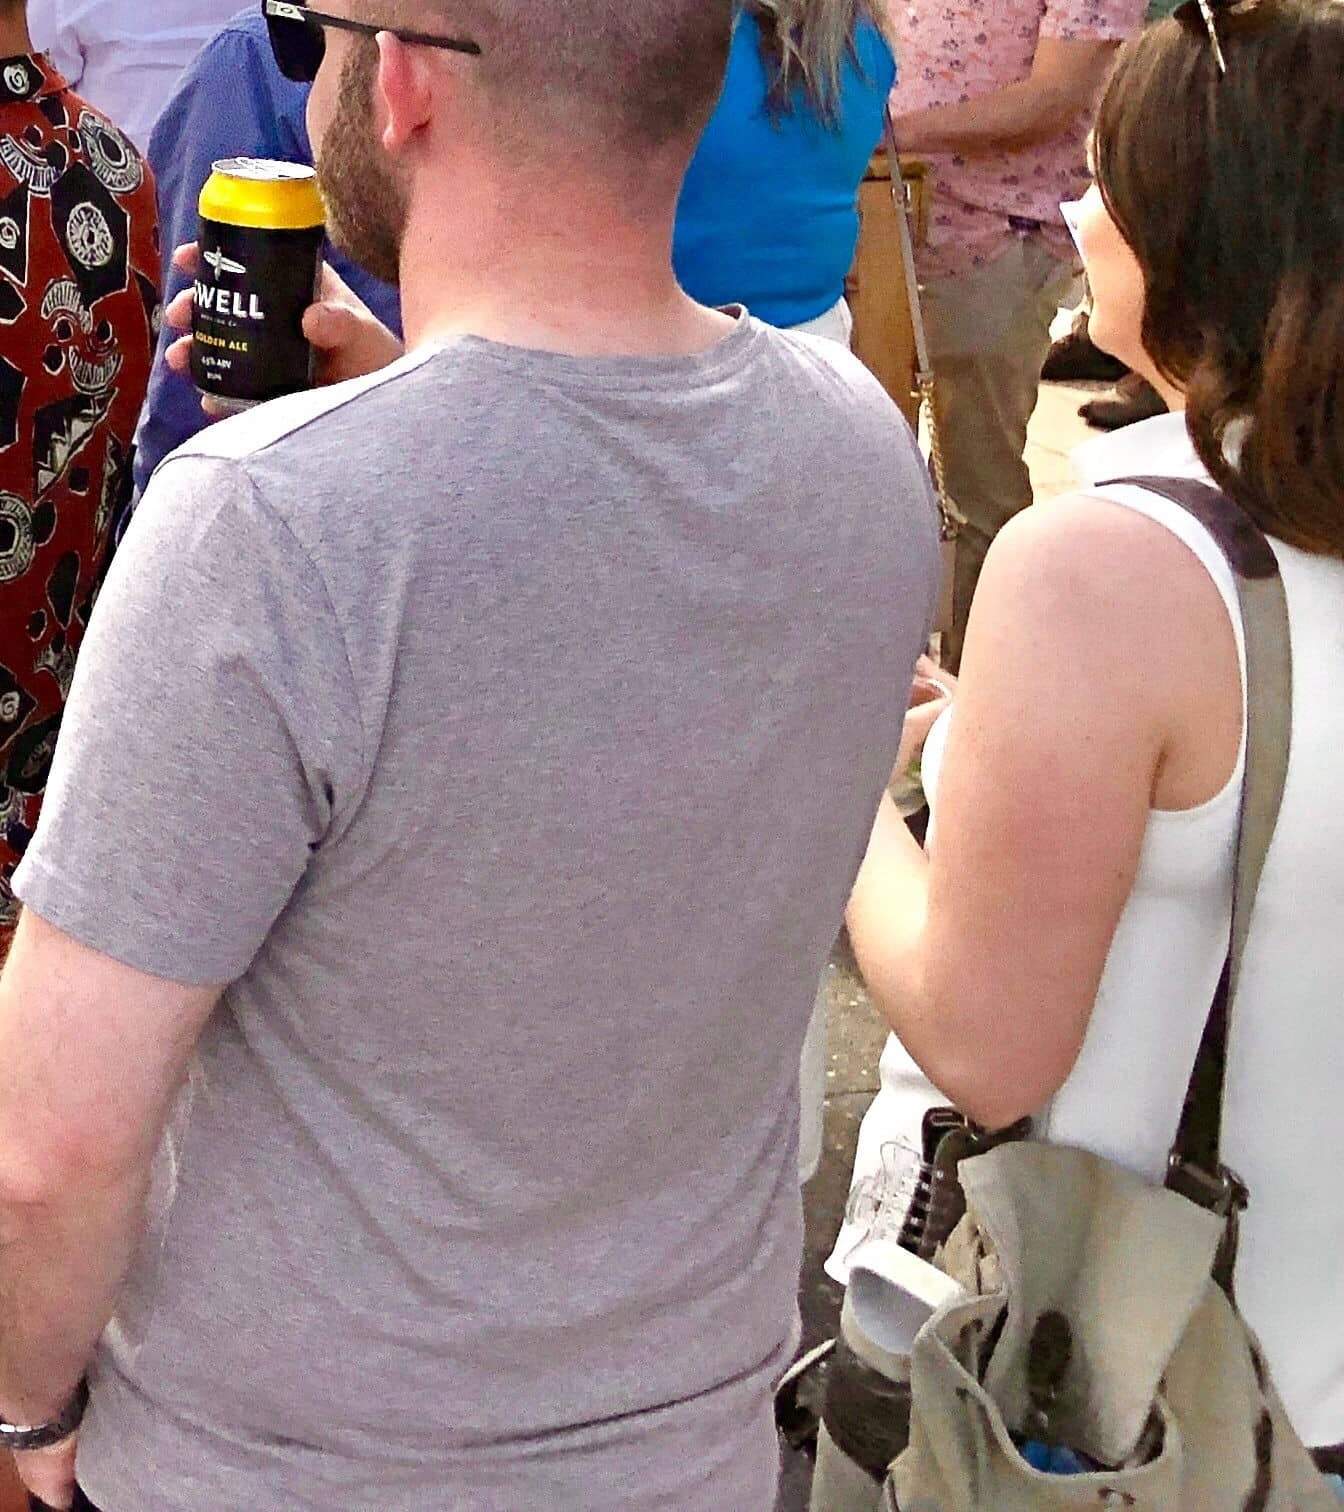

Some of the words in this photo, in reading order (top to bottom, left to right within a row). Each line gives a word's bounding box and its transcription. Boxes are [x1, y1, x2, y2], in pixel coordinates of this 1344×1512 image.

[195, 279, 265, 320] WELL
[195, 330, 226, 348] GOLDEN
[228, 340, 249, 353] ALE
